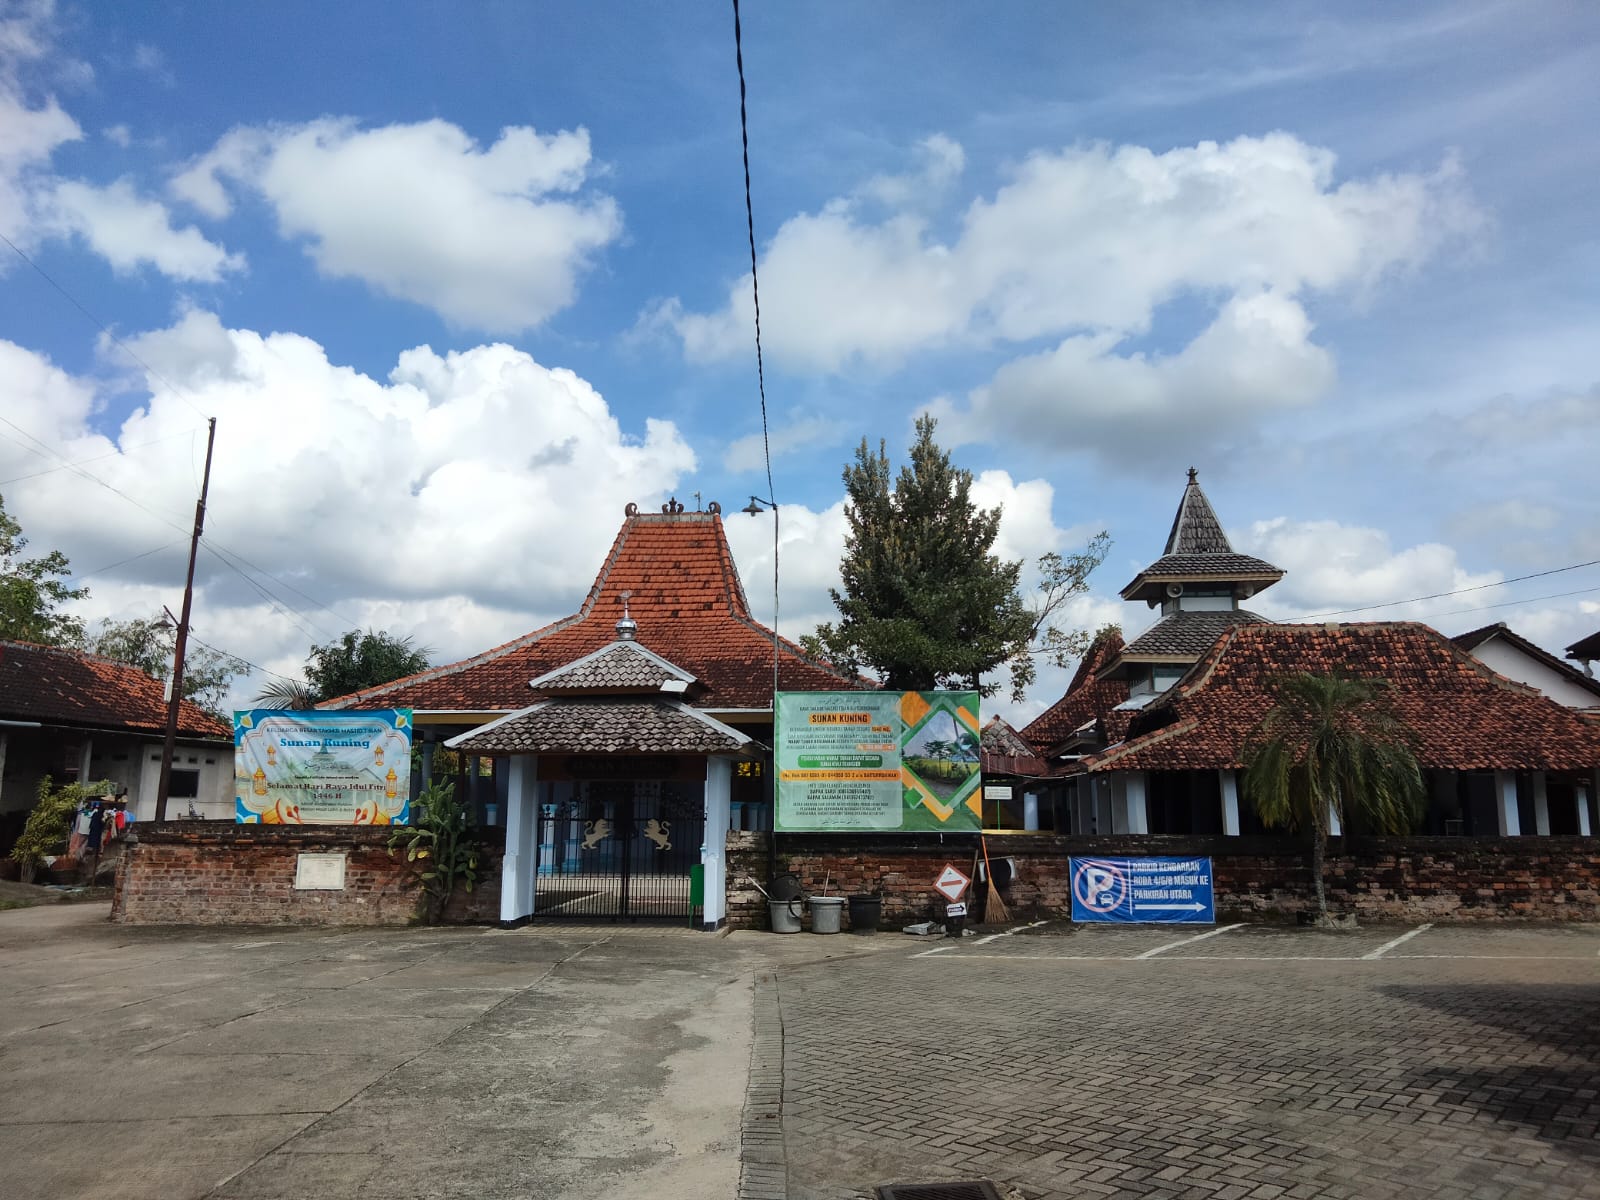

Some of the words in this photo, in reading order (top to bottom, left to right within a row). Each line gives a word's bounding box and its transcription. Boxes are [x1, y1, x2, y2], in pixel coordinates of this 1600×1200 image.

[812, 714, 837, 723] SUNAN
[839, 714, 868, 723] KUNING
[280, 738, 321, 747] Sunan
[323, 737, 370, 749] Kuning
[266, 782, 303, 790] Selamat
[325, 783, 347, 791] Raya
[369, 783, 386, 791] Fitri
[1133, 862, 1158, 871] PARKIR
[1159, 861, 1200, 872] KENDARAAN
[1133, 875, 1153, 885] RODA
[1173, 875, 1199, 885] MASUK
[1200, 875, 1209, 885] KE
[1134, 889, 1169, 899] PARKIRAN
[1169, 889, 1193, 899] UTARA
